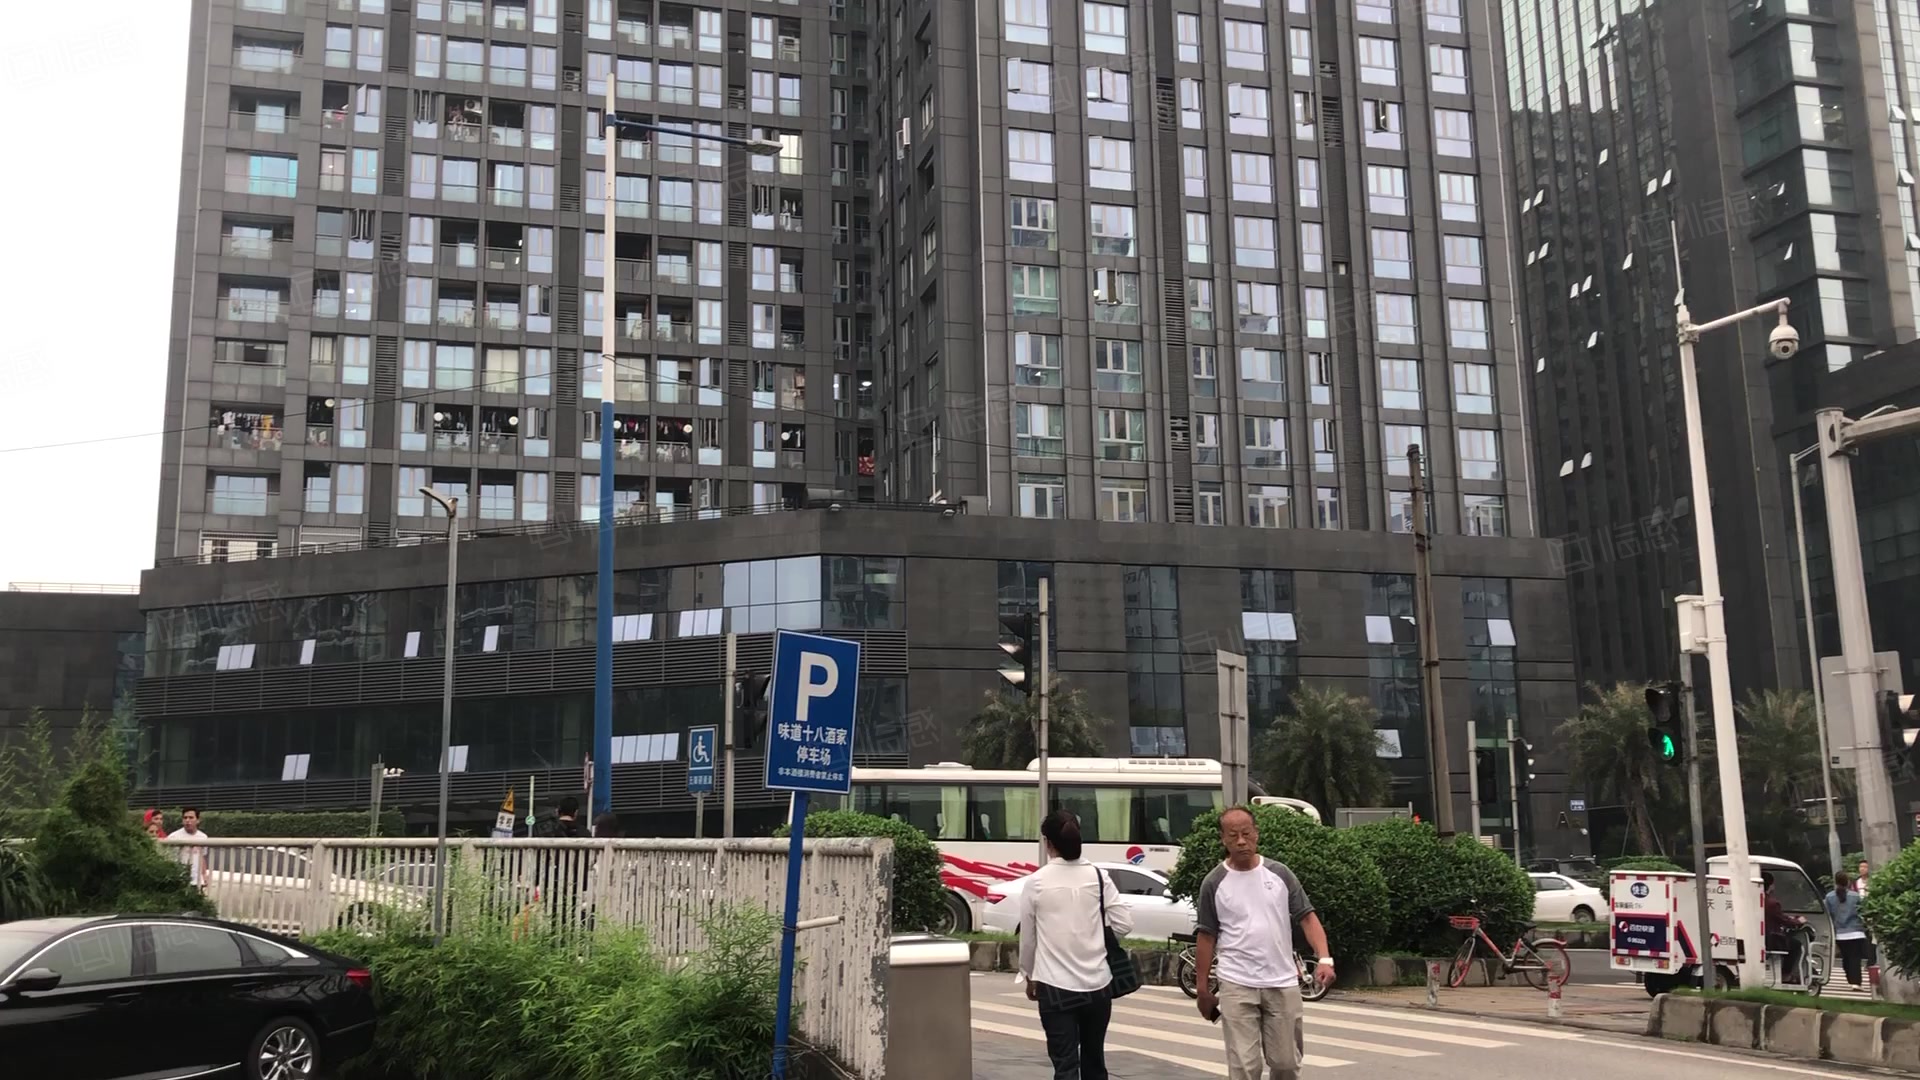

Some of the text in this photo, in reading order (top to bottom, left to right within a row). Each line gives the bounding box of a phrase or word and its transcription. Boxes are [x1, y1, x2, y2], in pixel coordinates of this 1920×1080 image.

[796, 651, 839, 722] P
[777, 722, 847, 746] 味道十八酒家
[796, 745, 831, 766] 停车场
